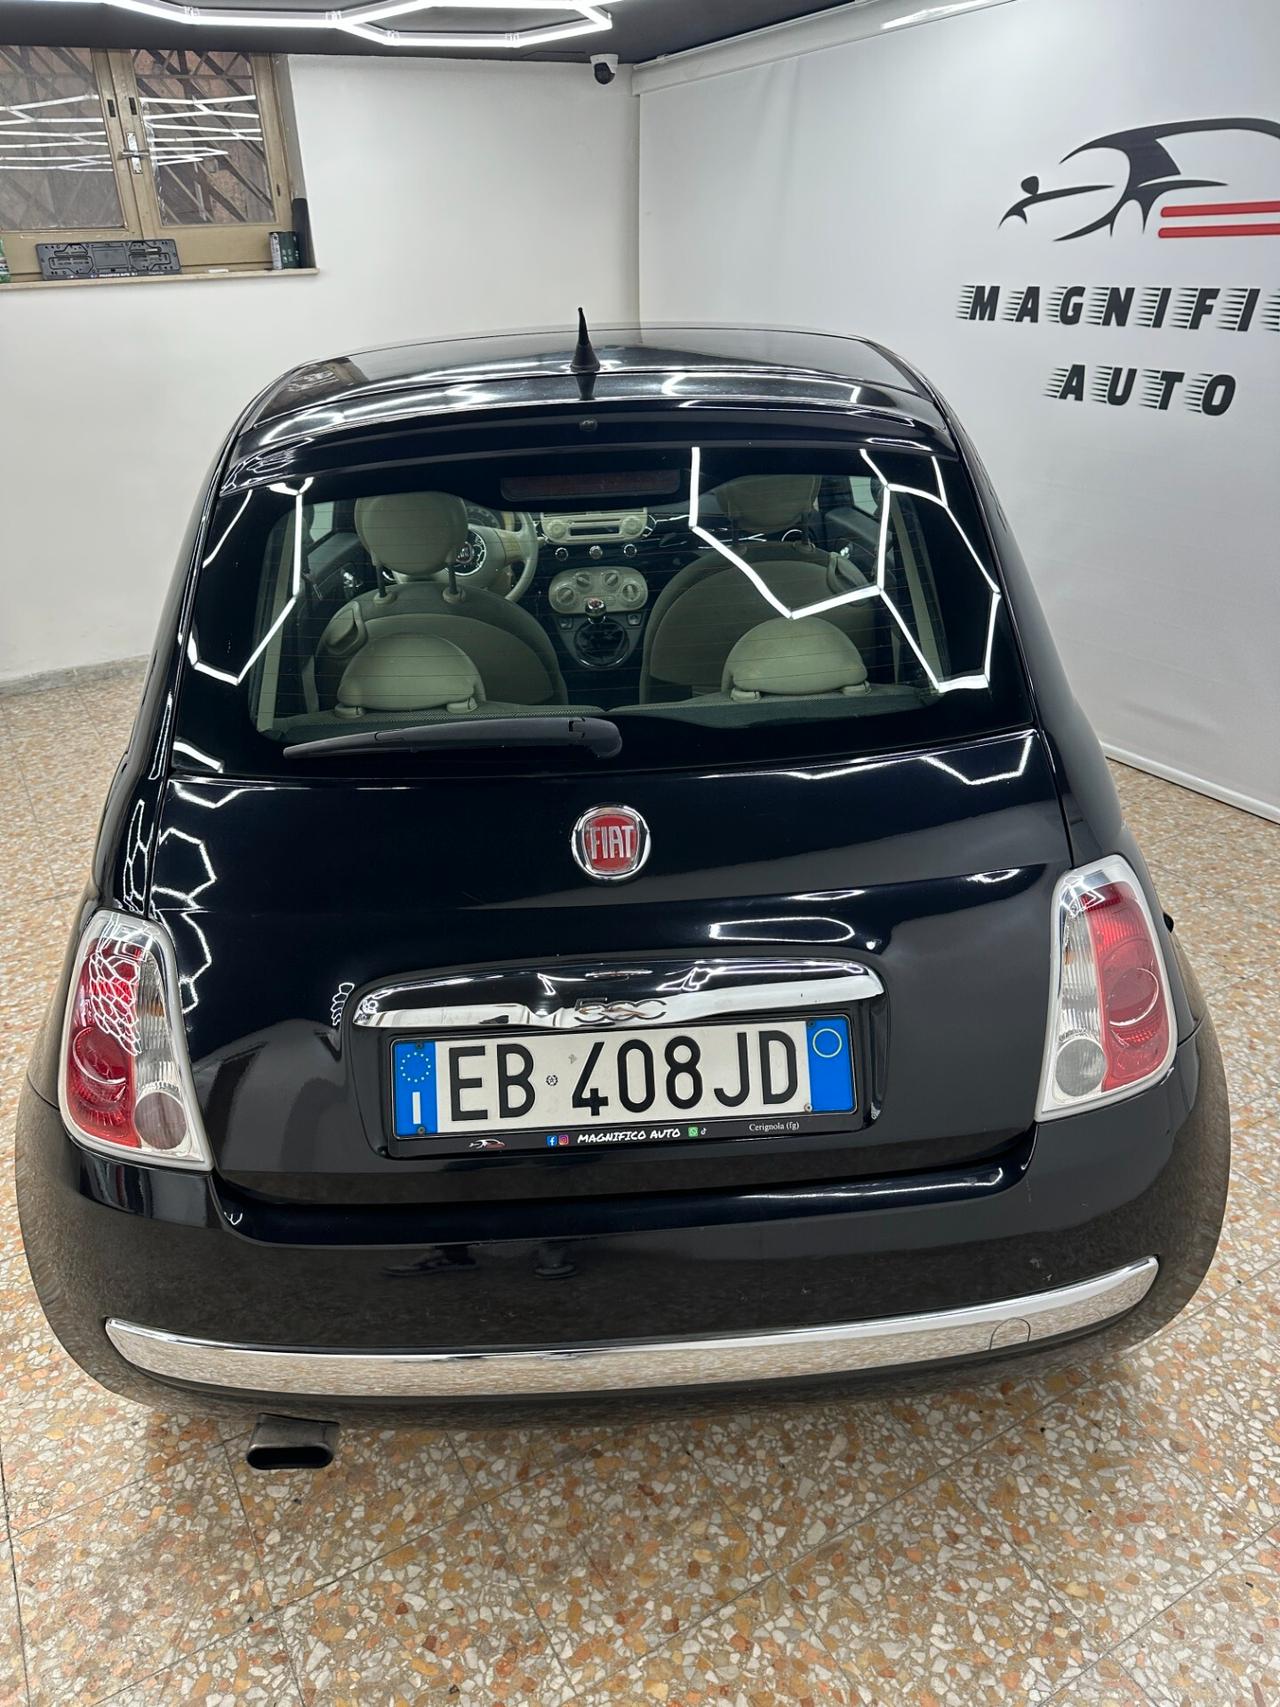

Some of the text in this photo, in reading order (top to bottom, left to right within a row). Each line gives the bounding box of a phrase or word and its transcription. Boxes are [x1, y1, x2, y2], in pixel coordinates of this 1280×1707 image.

[956, 285, 1280, 332] MAGNIFI
[1043, 364, 1237, 416] AUTO
[590, 825, 634, 860] FIAT
[449, 1043, 536, 1122] EB
[577, 1128, 681, 1144] MAGNIFICO AUTO
[748, 1121, 800, 1132] Cerignola (fg)
